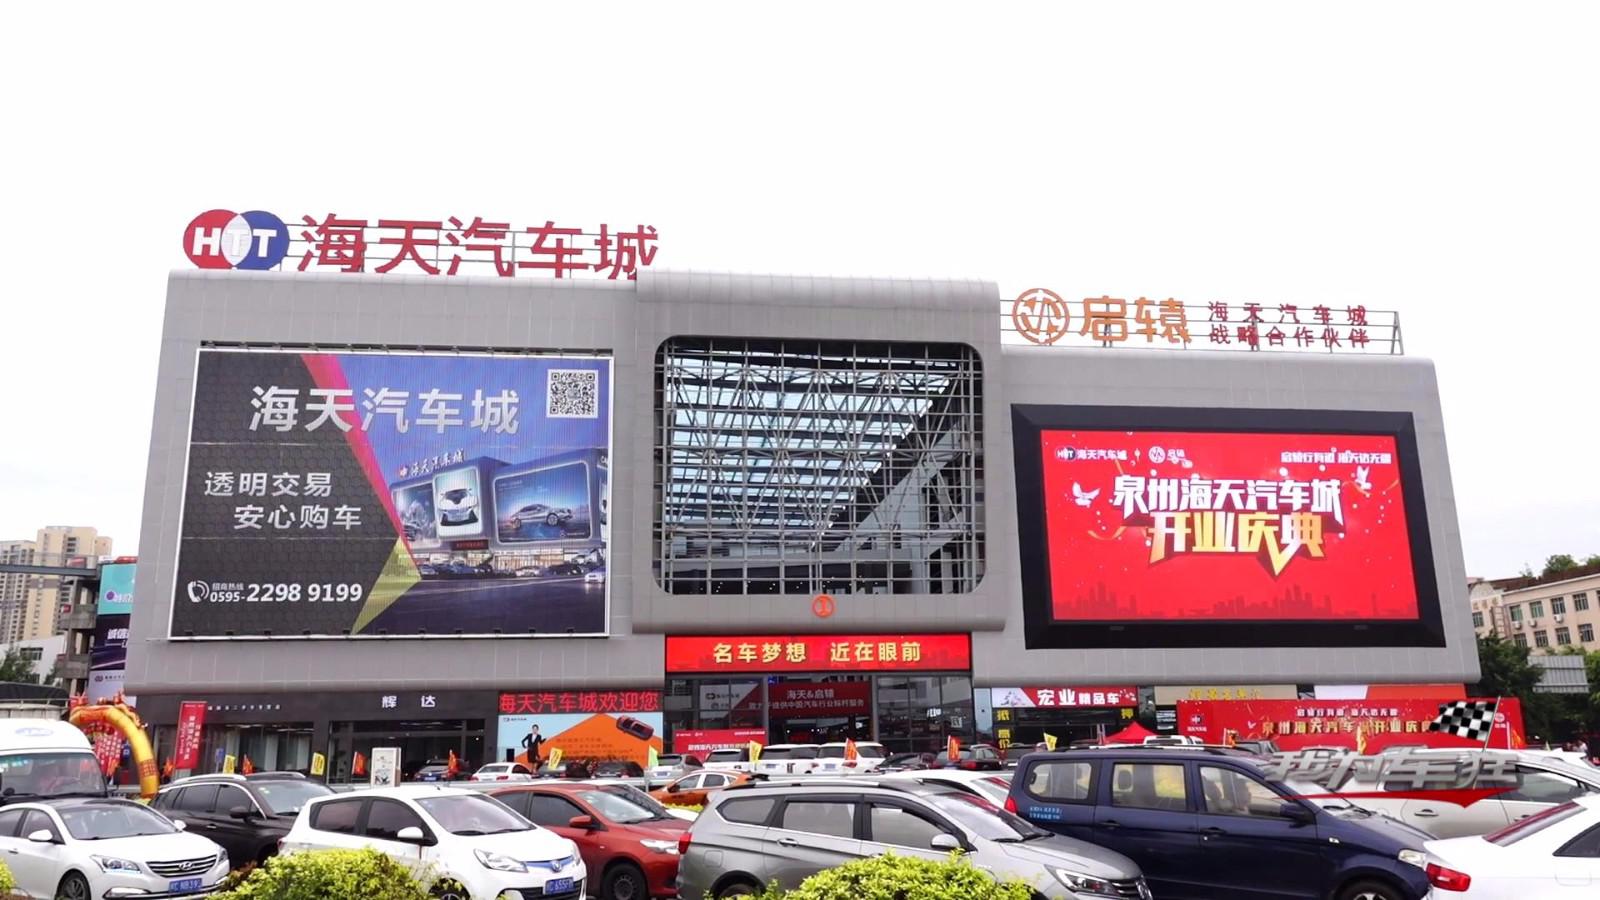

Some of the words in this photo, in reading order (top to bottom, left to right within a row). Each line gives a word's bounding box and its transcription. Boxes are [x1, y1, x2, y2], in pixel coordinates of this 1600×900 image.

[192, 226, 278, 258] HTT
[297, 213, 658, 280] 海天汽车城
[1080, 295, 1192, 344] 启辕
[1208, 300, 1369, 326] 海天汽车城
[1208, 324, 1371, 348] 战略合作伙伴
[249, 385, 520, 434] 海天汽车城
[204, 472, 332, 497] 透明交易
[1112, 474, 1344, 526] 泉州海天汽车城
[233, 505, 362, 530] 安心购车
[1148, 511, 1325, 576] 开业庆典
[307, 583, 363, 602] 9199
[713, 643, 807, 664] 名车梦想
[830, 642, 921, 662] 近在眼前
